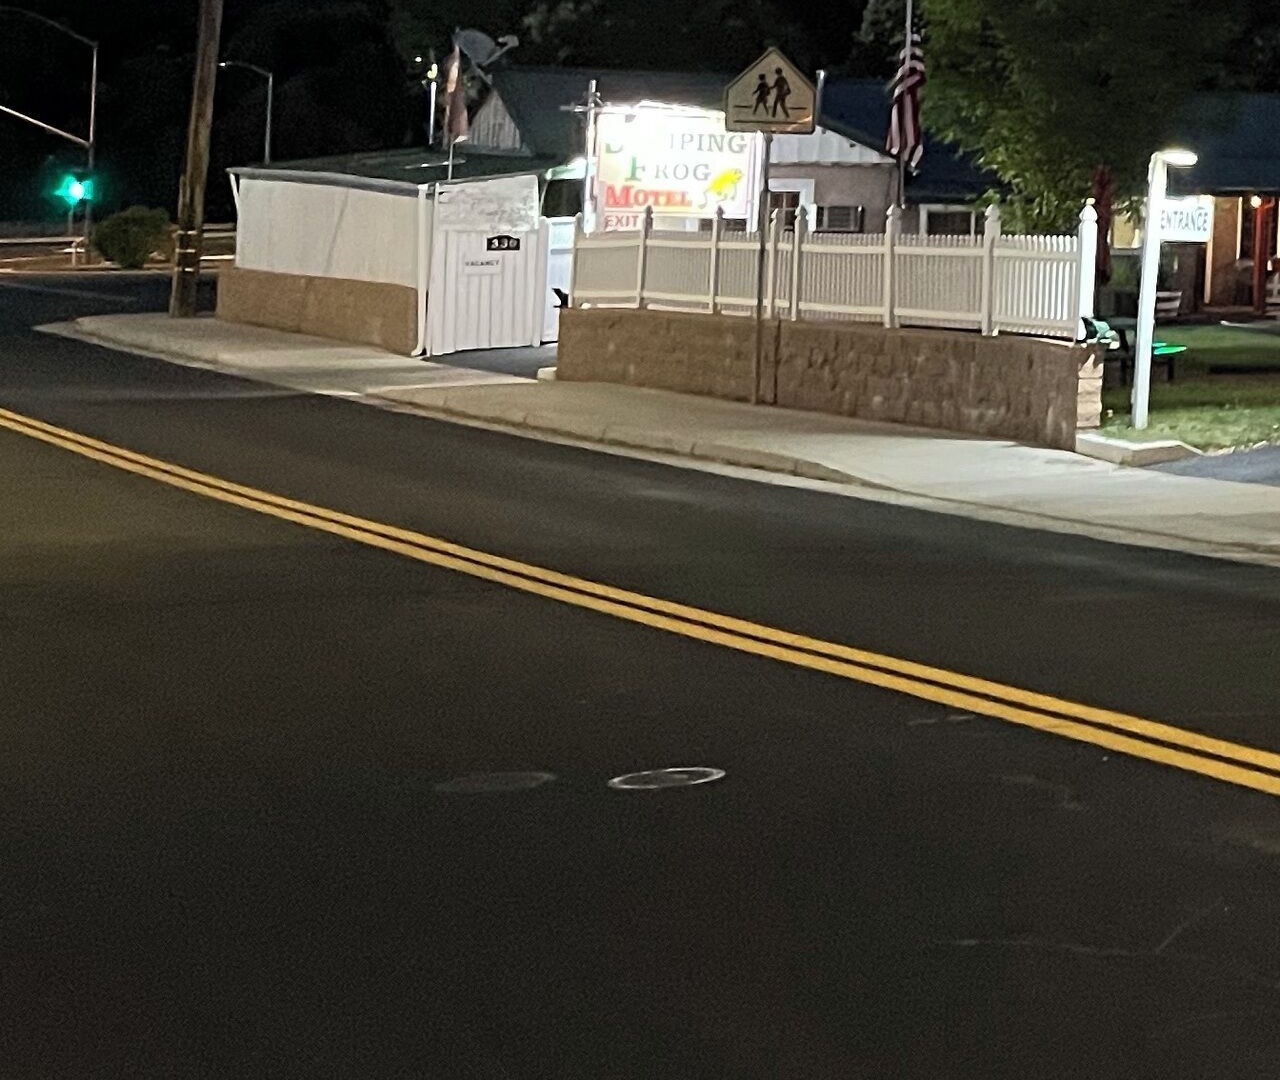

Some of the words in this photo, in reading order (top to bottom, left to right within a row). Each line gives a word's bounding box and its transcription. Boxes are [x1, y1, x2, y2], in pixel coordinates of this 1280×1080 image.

[605, 133, 748, 155] PING
[624, 156, 711, 182] FROG
[604, 184, 693, 208] MOTEL
[603, 214, 640, 231] EXIT
[1160, 209, 1208, 232] ENTRANCE
